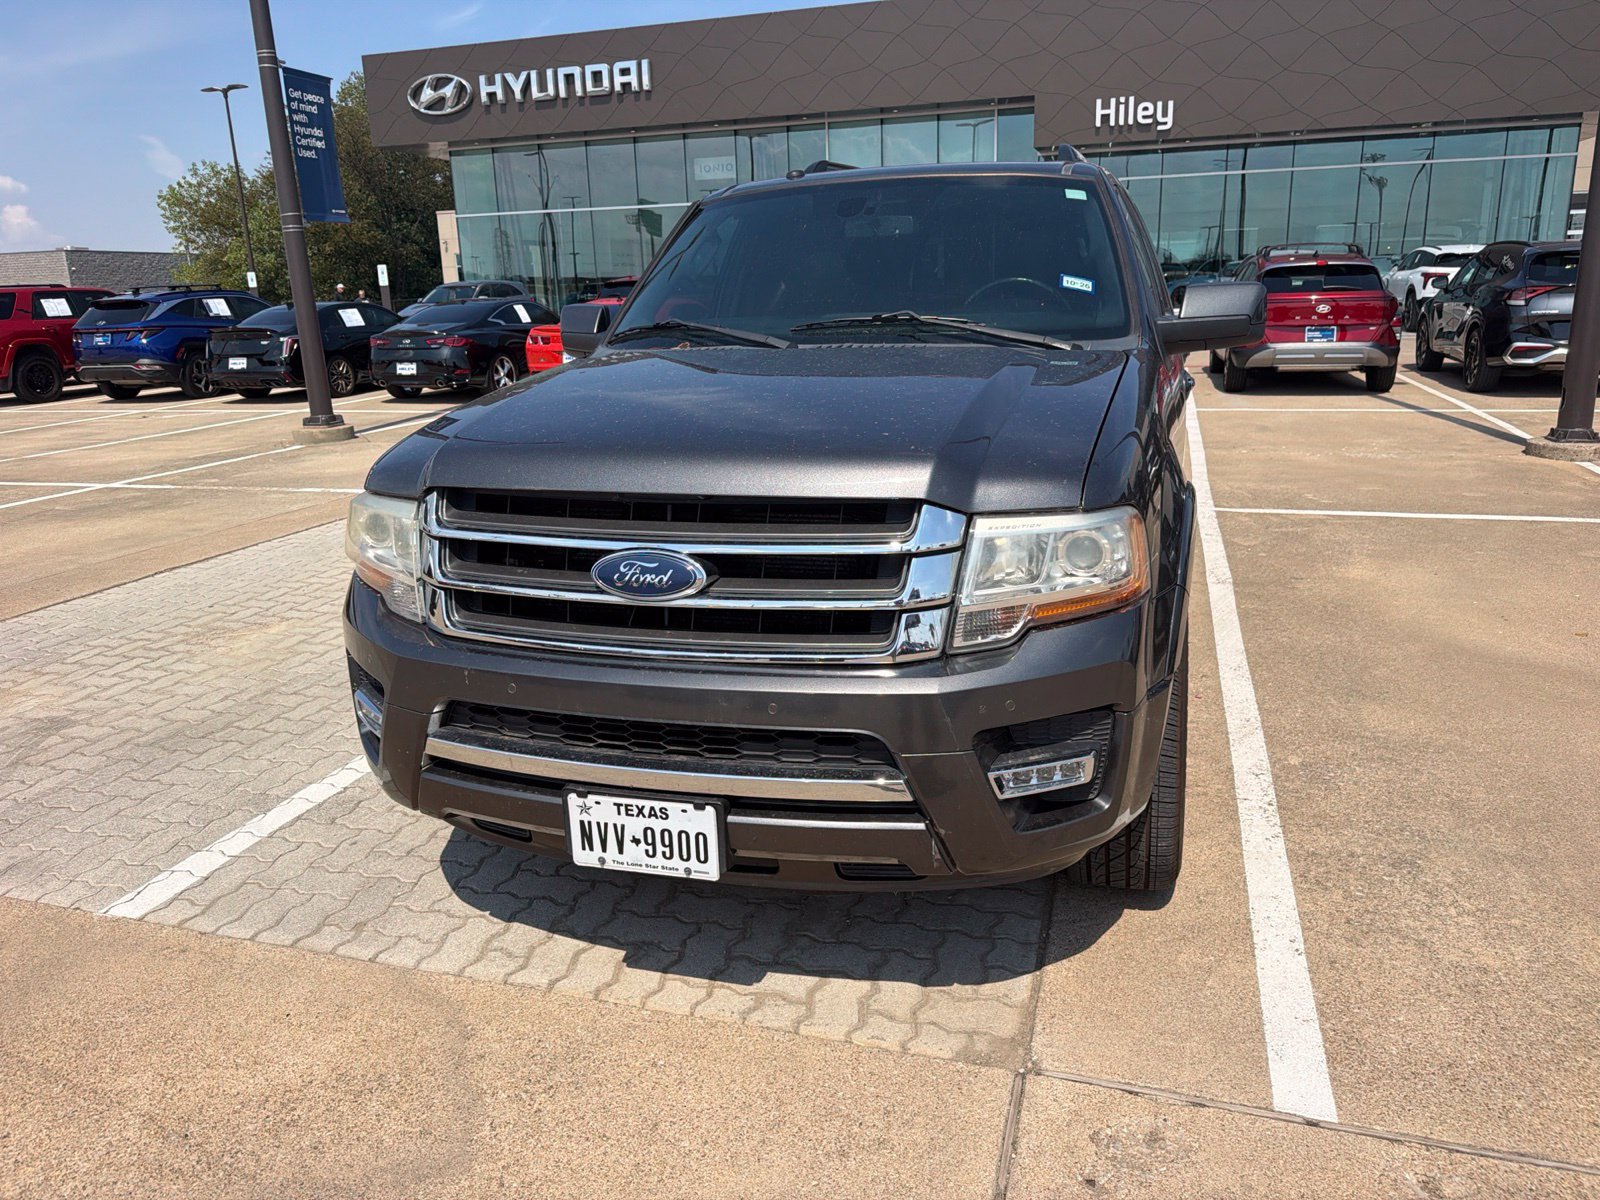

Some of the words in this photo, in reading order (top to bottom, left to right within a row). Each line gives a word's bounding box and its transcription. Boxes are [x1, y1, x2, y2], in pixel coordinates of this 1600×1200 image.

[478, 58, 652, 106] HYUNDAI
[288, 87, 302, 99] Get
[302, 92, 325, 104] peace
[290, 101, 299, 110] of
[299, 102, 318, 114] mind
[1095, 95, 1174, 130] Hiley
[291, 112, 309, 124] with
[293, 123, 324, 137] Hyundai
[295, 135, 326, 149] Certified
[297, 147, 319, 159] Used.
[613, 560, 673, 589] Ford
[613, 802, 670, 821] TEXAS
[579, 819, 626, 855] NVV
[642, 826, 709, 865] 9900
[660, 865, 680, 873] State
